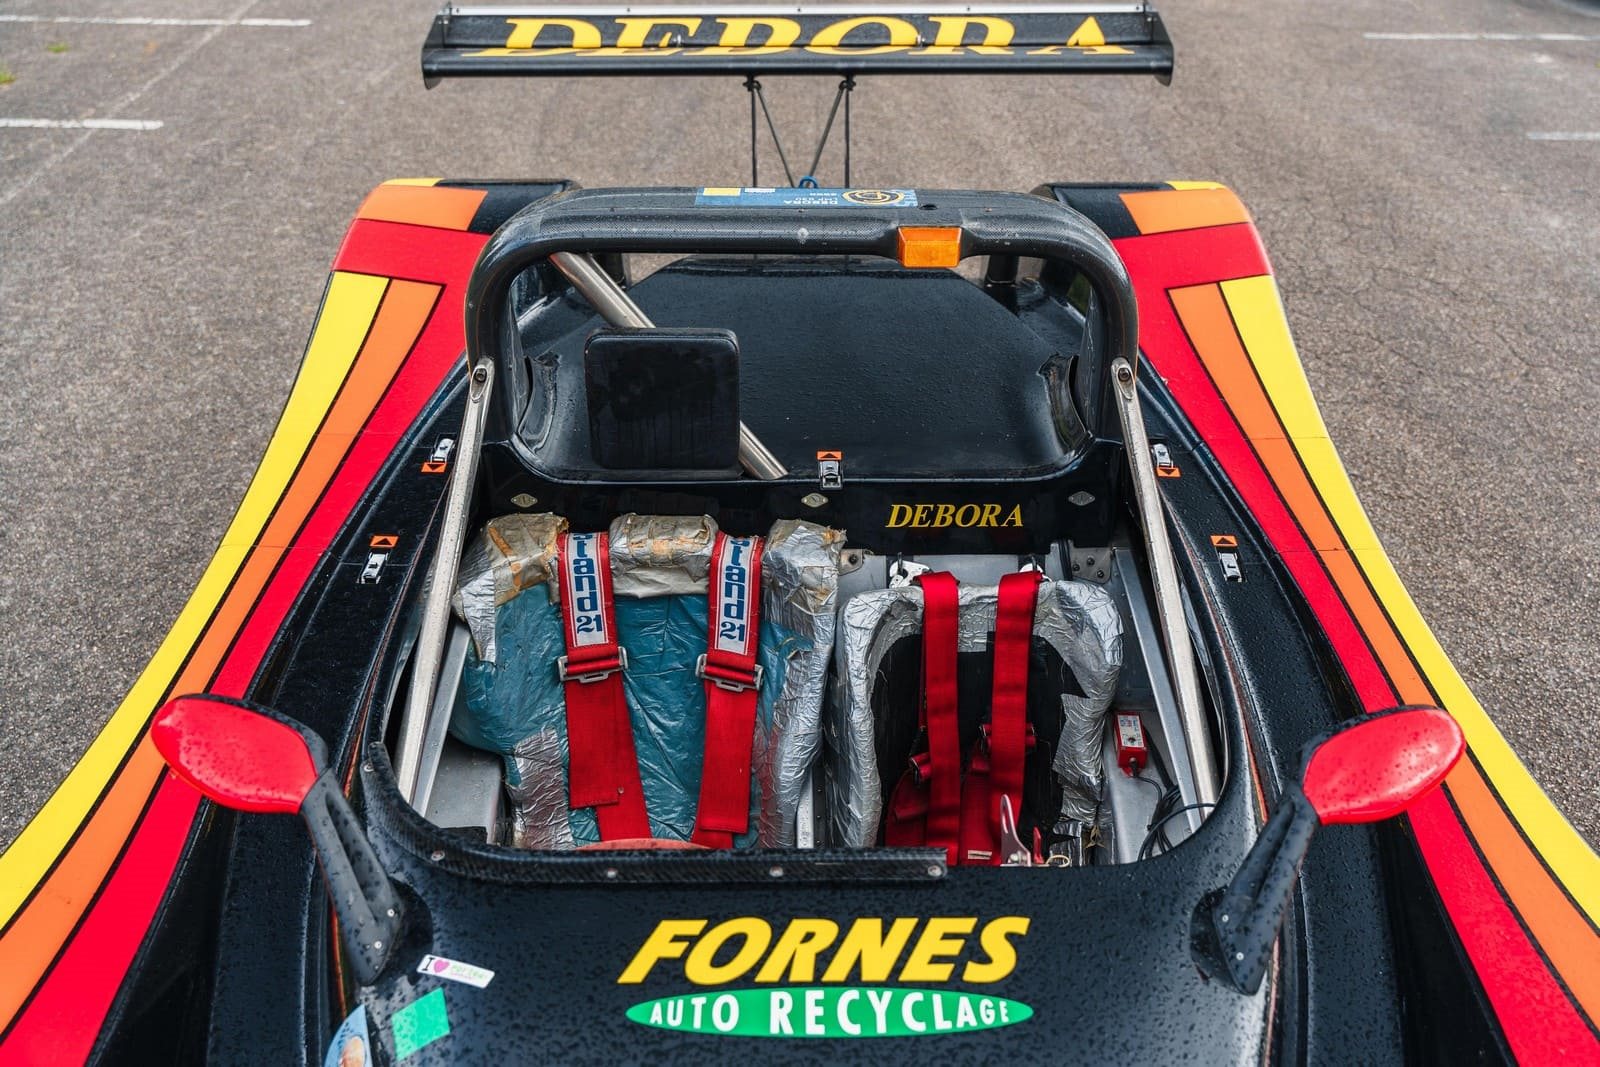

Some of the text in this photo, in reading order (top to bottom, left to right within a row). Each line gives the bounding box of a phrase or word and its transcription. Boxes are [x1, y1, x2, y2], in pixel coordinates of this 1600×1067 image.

[462, 16, 1136, 57] DEBORA
[885, 503, 1024, 529] DEBORA
[576, 613, 603, 634] 21
[719, 620, 746, 642] 21
[617, 916, 1031, 986] FORNES
[649, 989, 1010, 1035] AUTO RECYCLAGE
